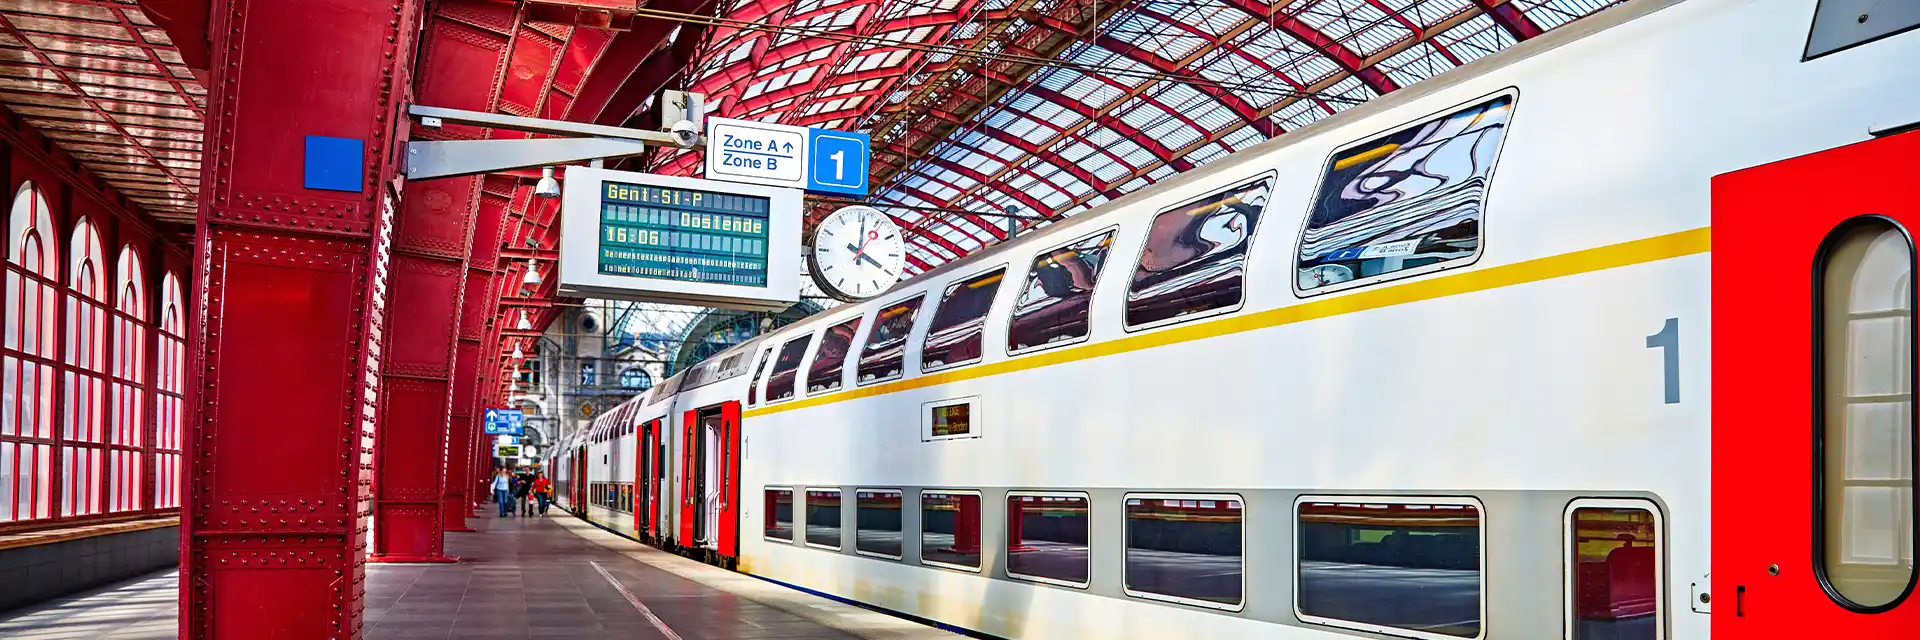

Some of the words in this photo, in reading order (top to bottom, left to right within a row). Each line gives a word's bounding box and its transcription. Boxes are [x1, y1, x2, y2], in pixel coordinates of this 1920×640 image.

[723, 134, 762, 150] Zone
[767, 139, 778, 152] A
[723, 153, 762, 169] Zone
[767, 158, 777, 170] B
[830, 150, 844, 180] 1
[608, 184, 702, 206] Gent-St-P
[681, 212, 762, 234] Oostende
[608, 226, 659, 245] 16:06
[1646, 317, 1680, 404] 1
